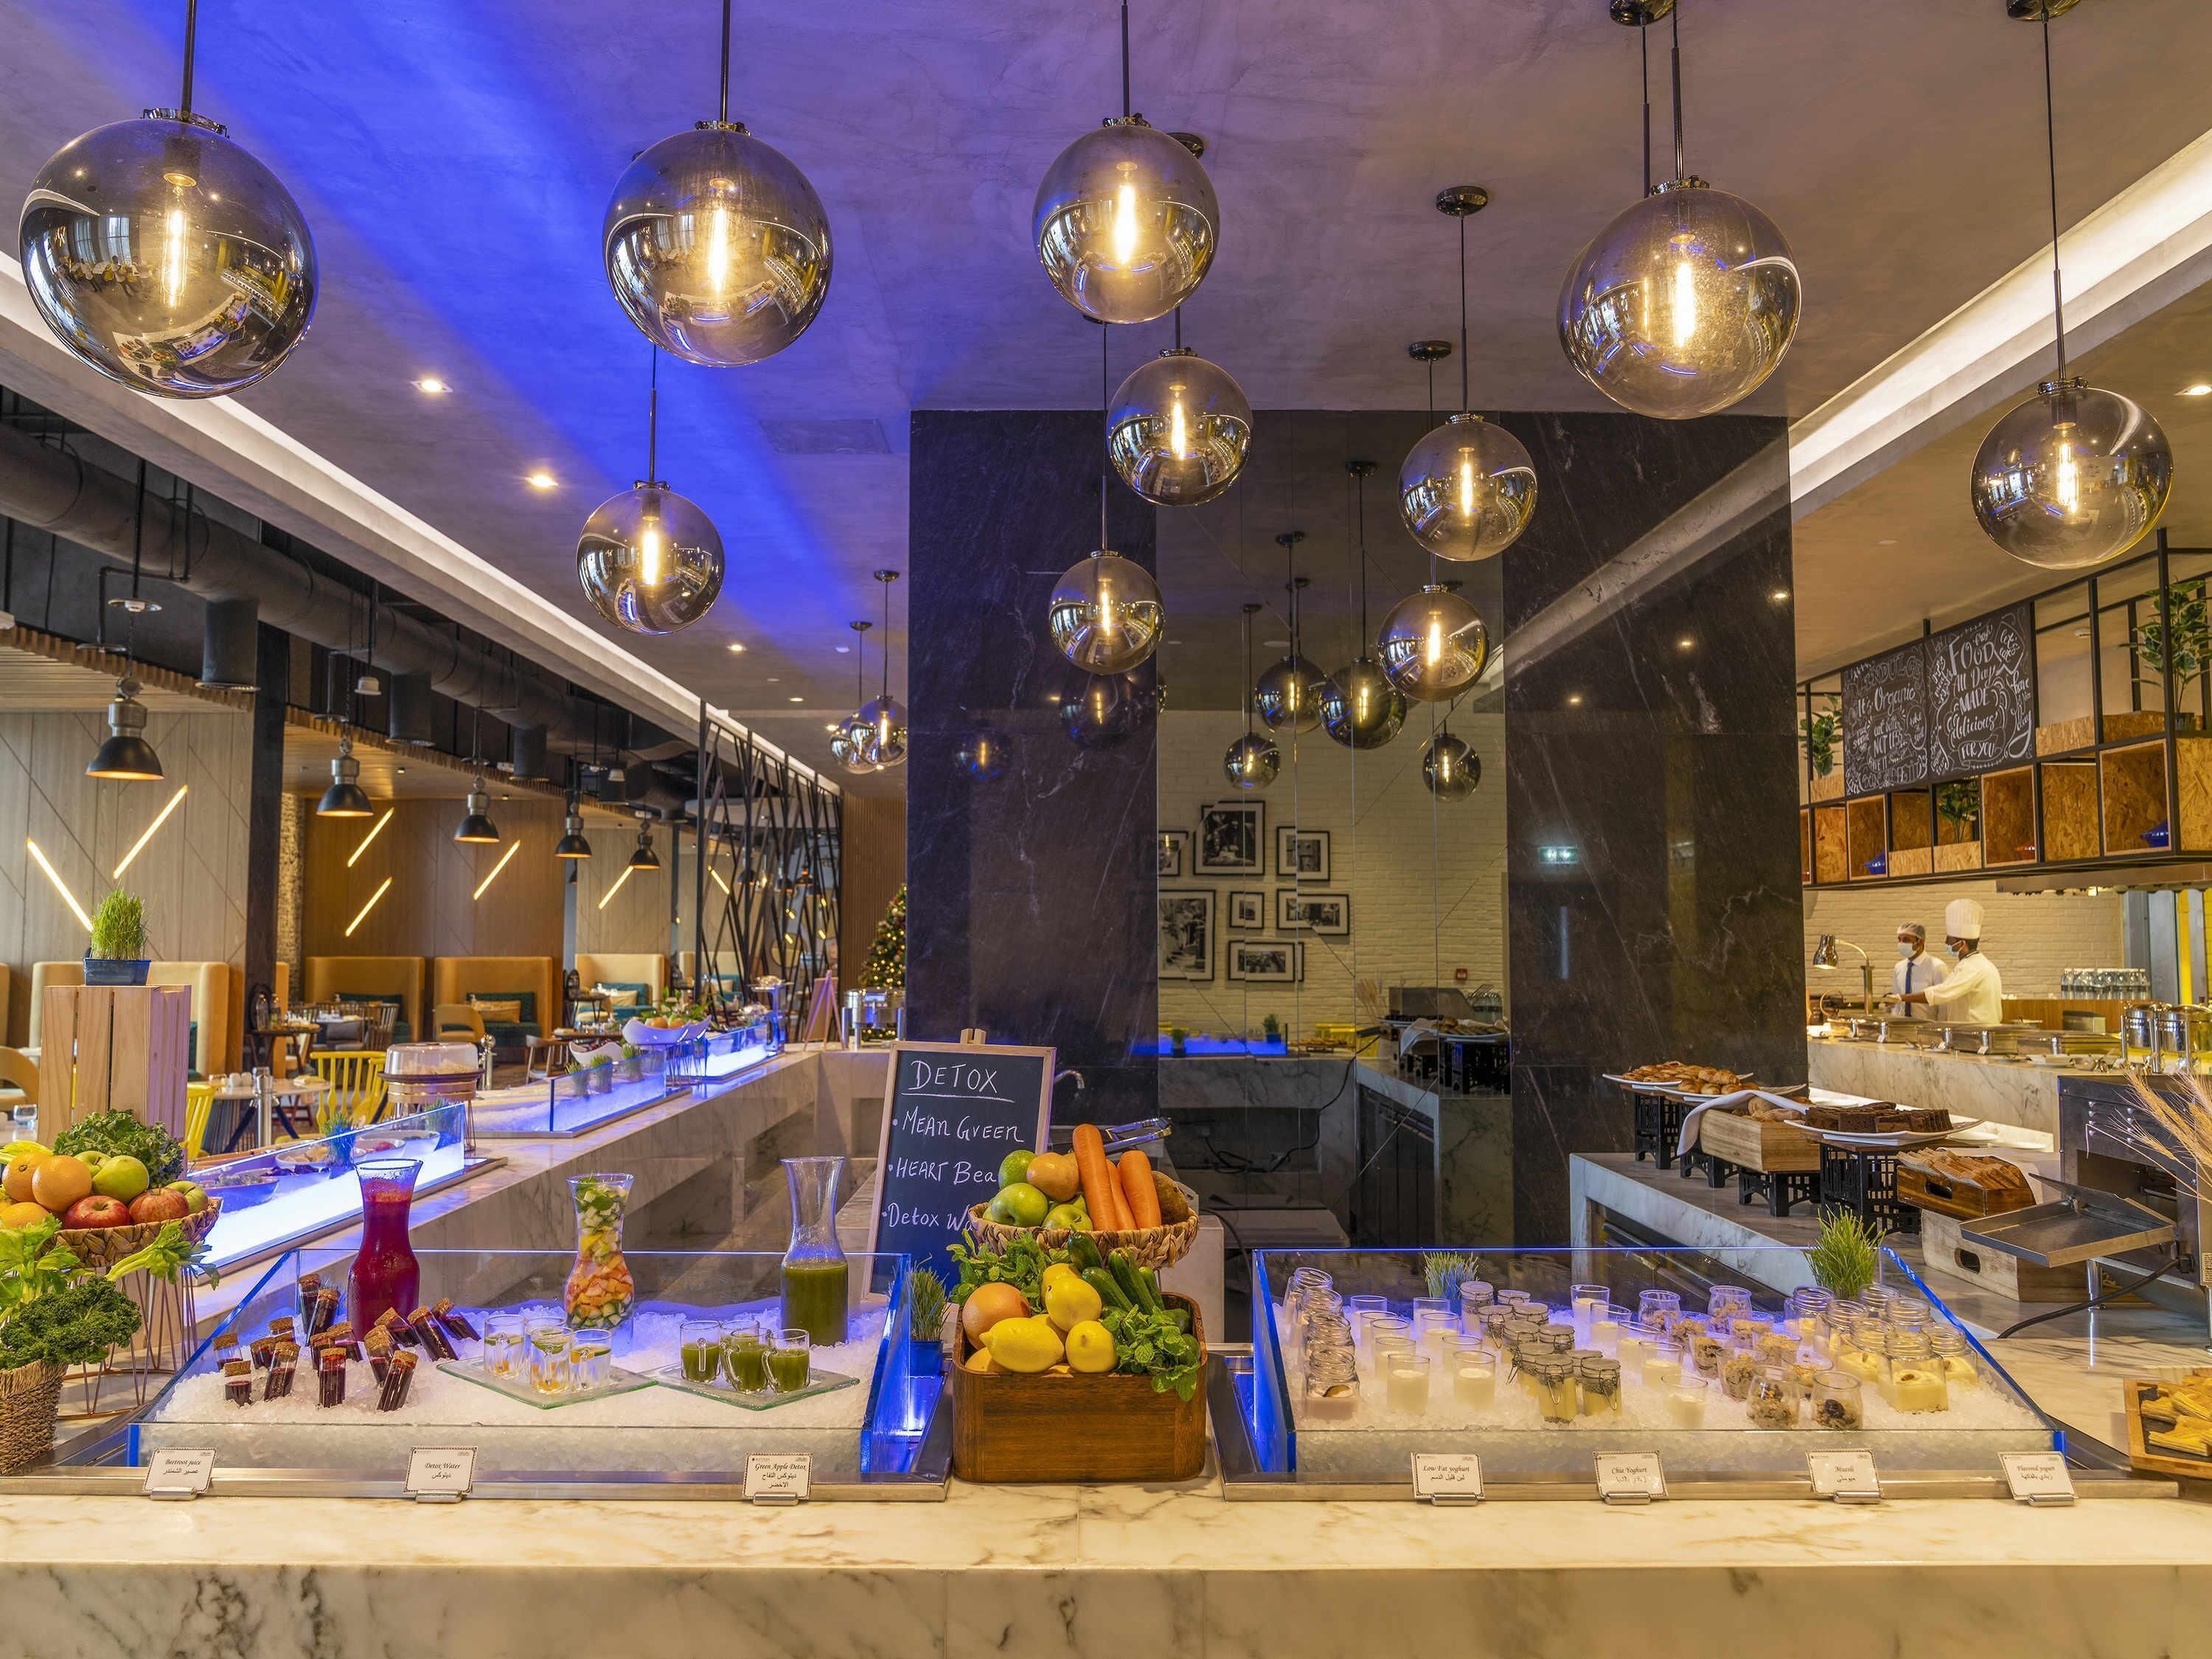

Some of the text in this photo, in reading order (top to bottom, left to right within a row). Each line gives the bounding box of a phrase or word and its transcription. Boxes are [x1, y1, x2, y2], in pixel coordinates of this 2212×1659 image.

[1949, 636, 1994, 675] FOOD
[1970, 665, 1995, 689] Day
[1959, 688, 1990, 714] MADE
[1961, 742, 1978, 759] FOR
[1978, 742, 1994, 758] YOU
[908, 1060, 997, 1093] DETOX
[896, 1157, 997, 1186] HEART Bea
[887, 1203, 939, 1228] Detox
[187, 1459, 201, 1467] juice
[425, 1462, 442, 1470] Detox
[755, 1463, 807, 1472] Green Apple Detox
[1449, 1464, 1470, 1473] yoghurt
[1611, 1466, 1648, 1475] Chia Yoghurt
